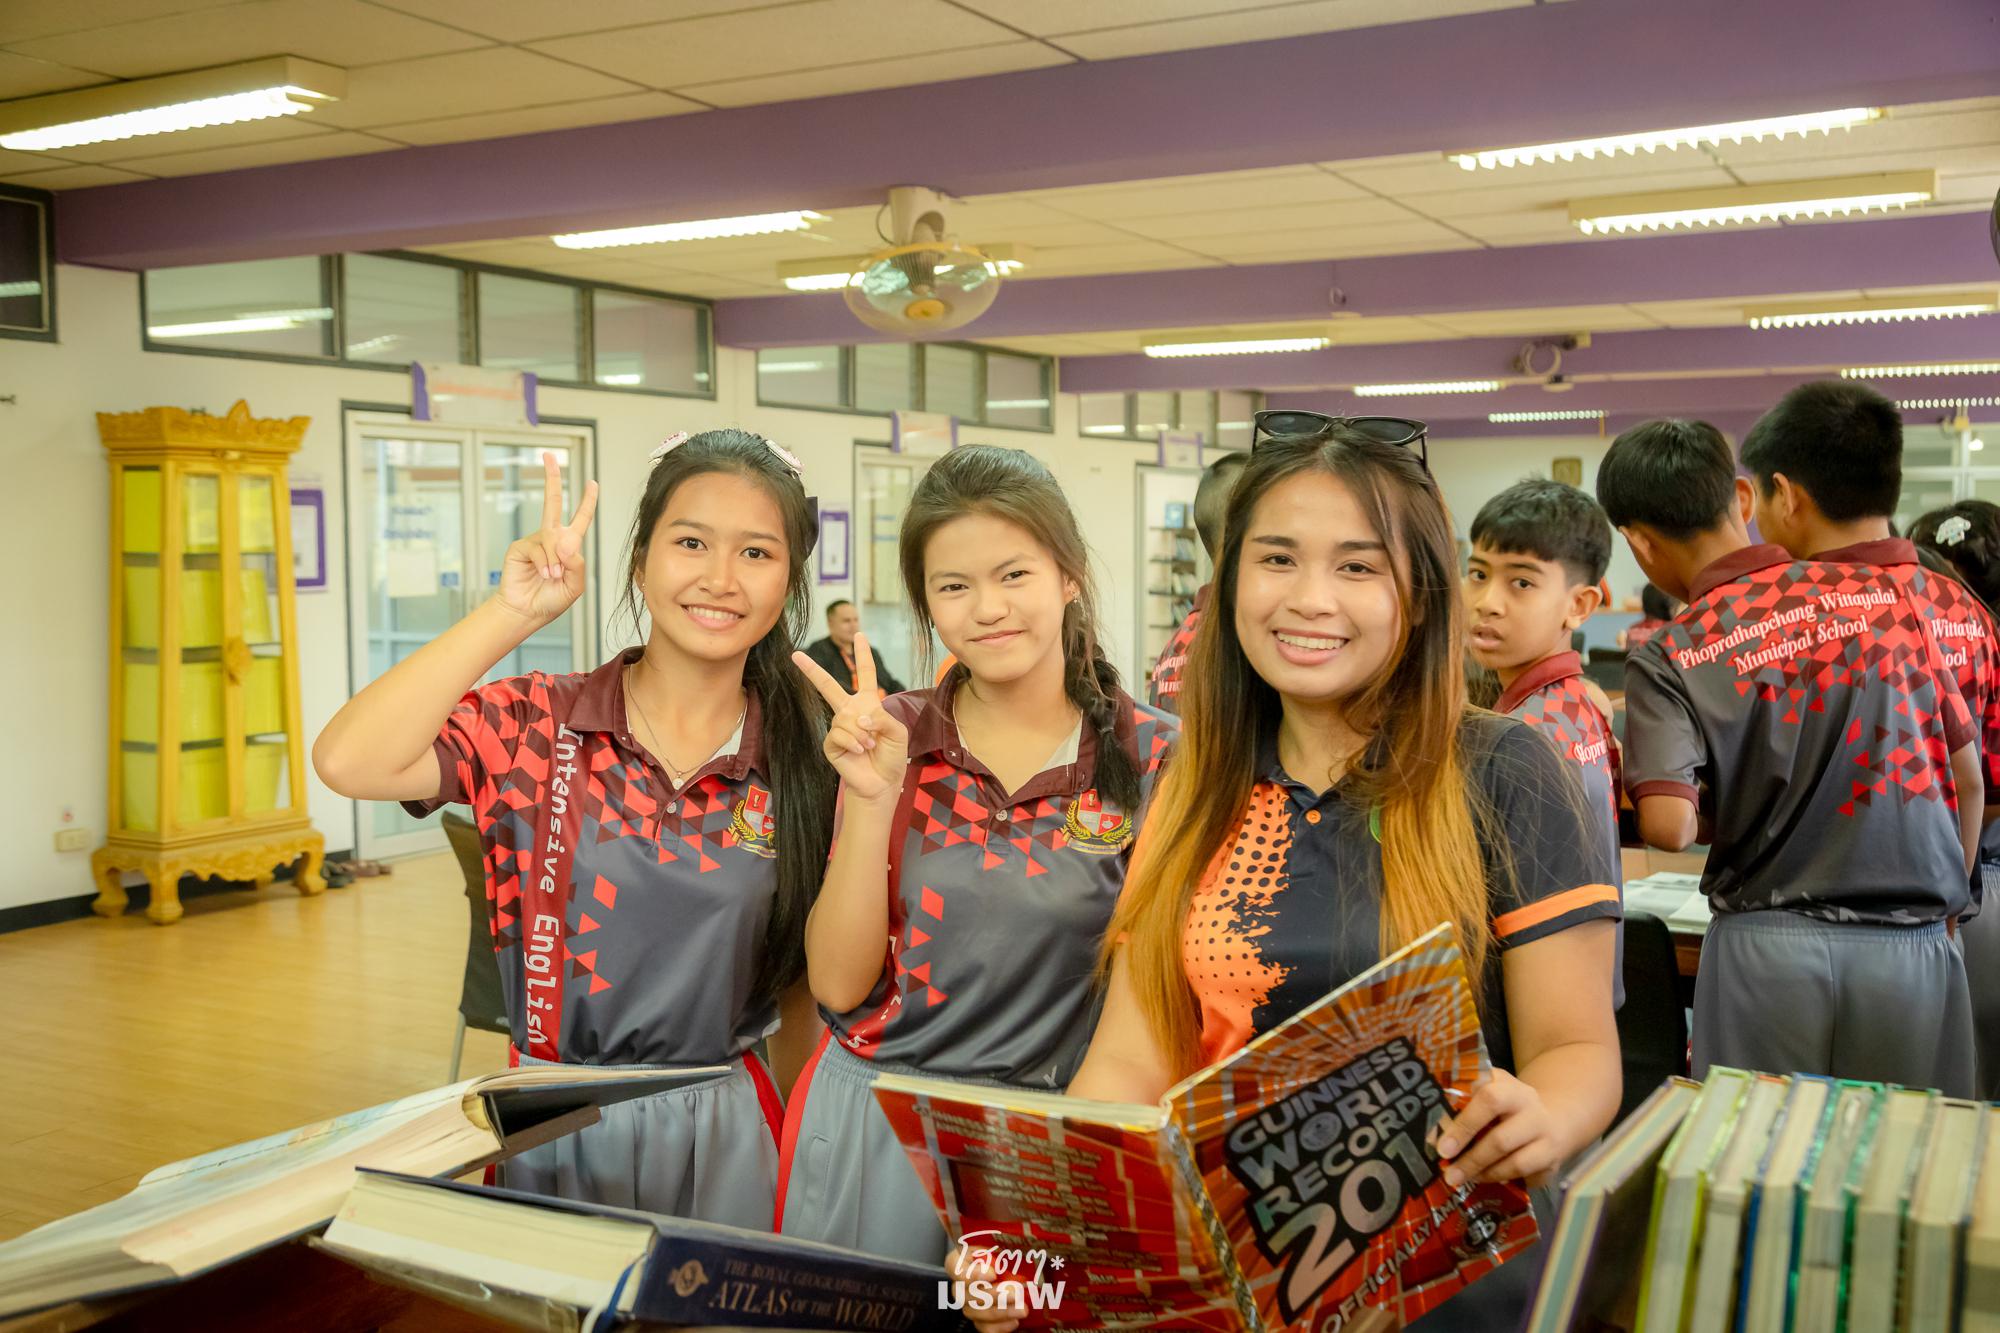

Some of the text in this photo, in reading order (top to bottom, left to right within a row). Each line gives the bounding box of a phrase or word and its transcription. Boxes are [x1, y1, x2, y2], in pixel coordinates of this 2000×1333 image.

[1678, 588, 1898, 669] Phoprathapchang Wittayalai
[1734, 615, 1869, 675] Municipal School
[539, 723, 584, 894] Intensive
[1229, 1040, 1409, 1154] GUINNESS
[1238, 1060, 1424, 1190] WORLD
[1253, 1079, 1441, 1233] RECORDS
[708, 1280, 792, 1316] ATLAS
[834, 1297, 915, 1332] WORLD
[724, 1259, 748, 1276] THE
[751, 1263, 789, 1284] ROYAL
[1320, 1220, 1430, 1333] OFFICIALLY
